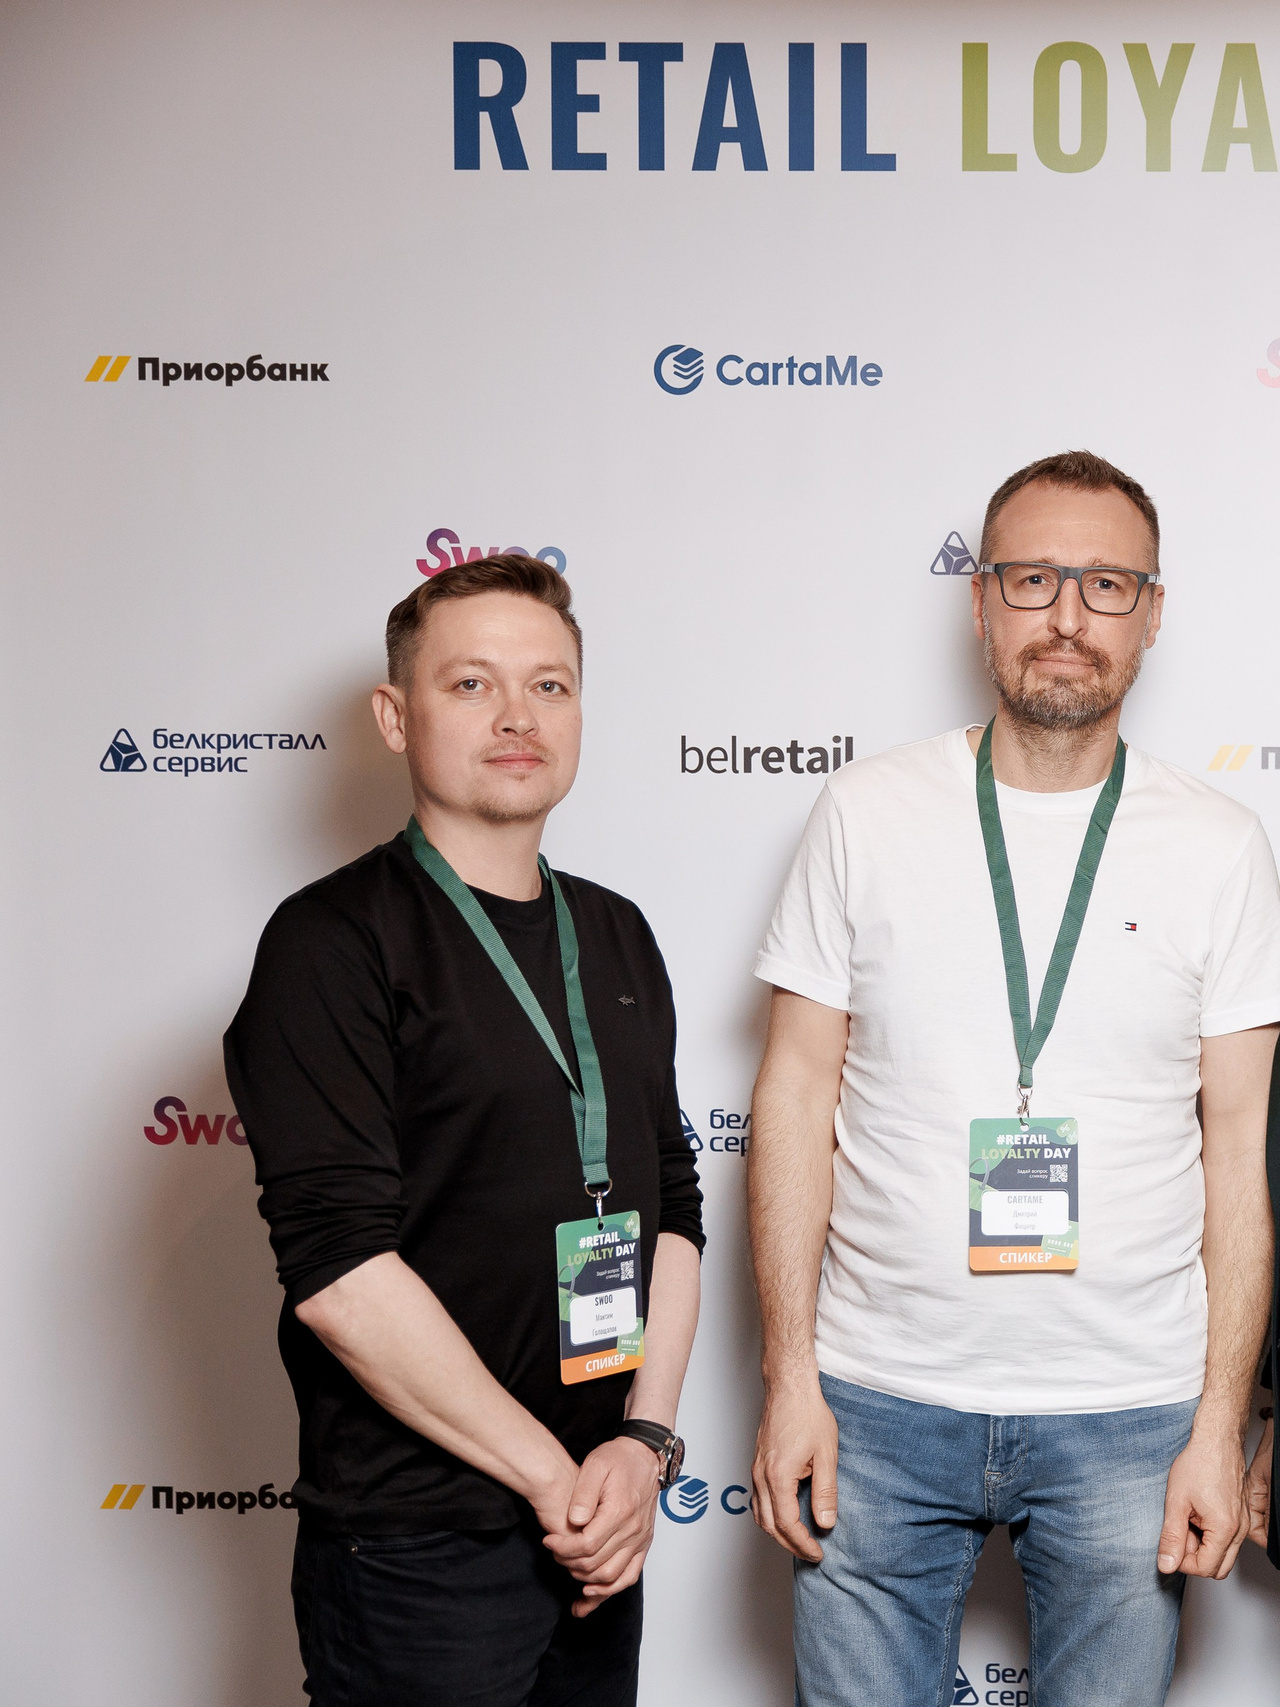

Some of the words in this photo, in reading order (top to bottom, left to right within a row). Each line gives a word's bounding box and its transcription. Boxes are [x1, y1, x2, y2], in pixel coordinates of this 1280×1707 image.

[453, 41, 897, 171] RETAIL
[137, 354, 330, 387] Приорбанк
[715, 354, 884, 387] CartaMe
[153, 728, 327, 750] белкристалл
[153, 753, 248, 777] сервис
[681, 735, 854, 775] belretail
[996, 1134, 1051, 1145] #RETAIL
[981, 1148, 1041, 1159] LOYALTY
[1043, 1147, 1072, 1159] DAY
[1007, 1195, 1044, 1204] CARTAME
[578, 1231, 621, 1249] #RETAIL
[566, 1246, 614, 1267] LOYALTY
[615, 1242, 636, 1257] DAY
[999, 1252, 1053, 1264] СПИКЕР
[594, 1294, 614, 1307] SWOO
[585, 1352, 626, 1373] СПИКЕР
